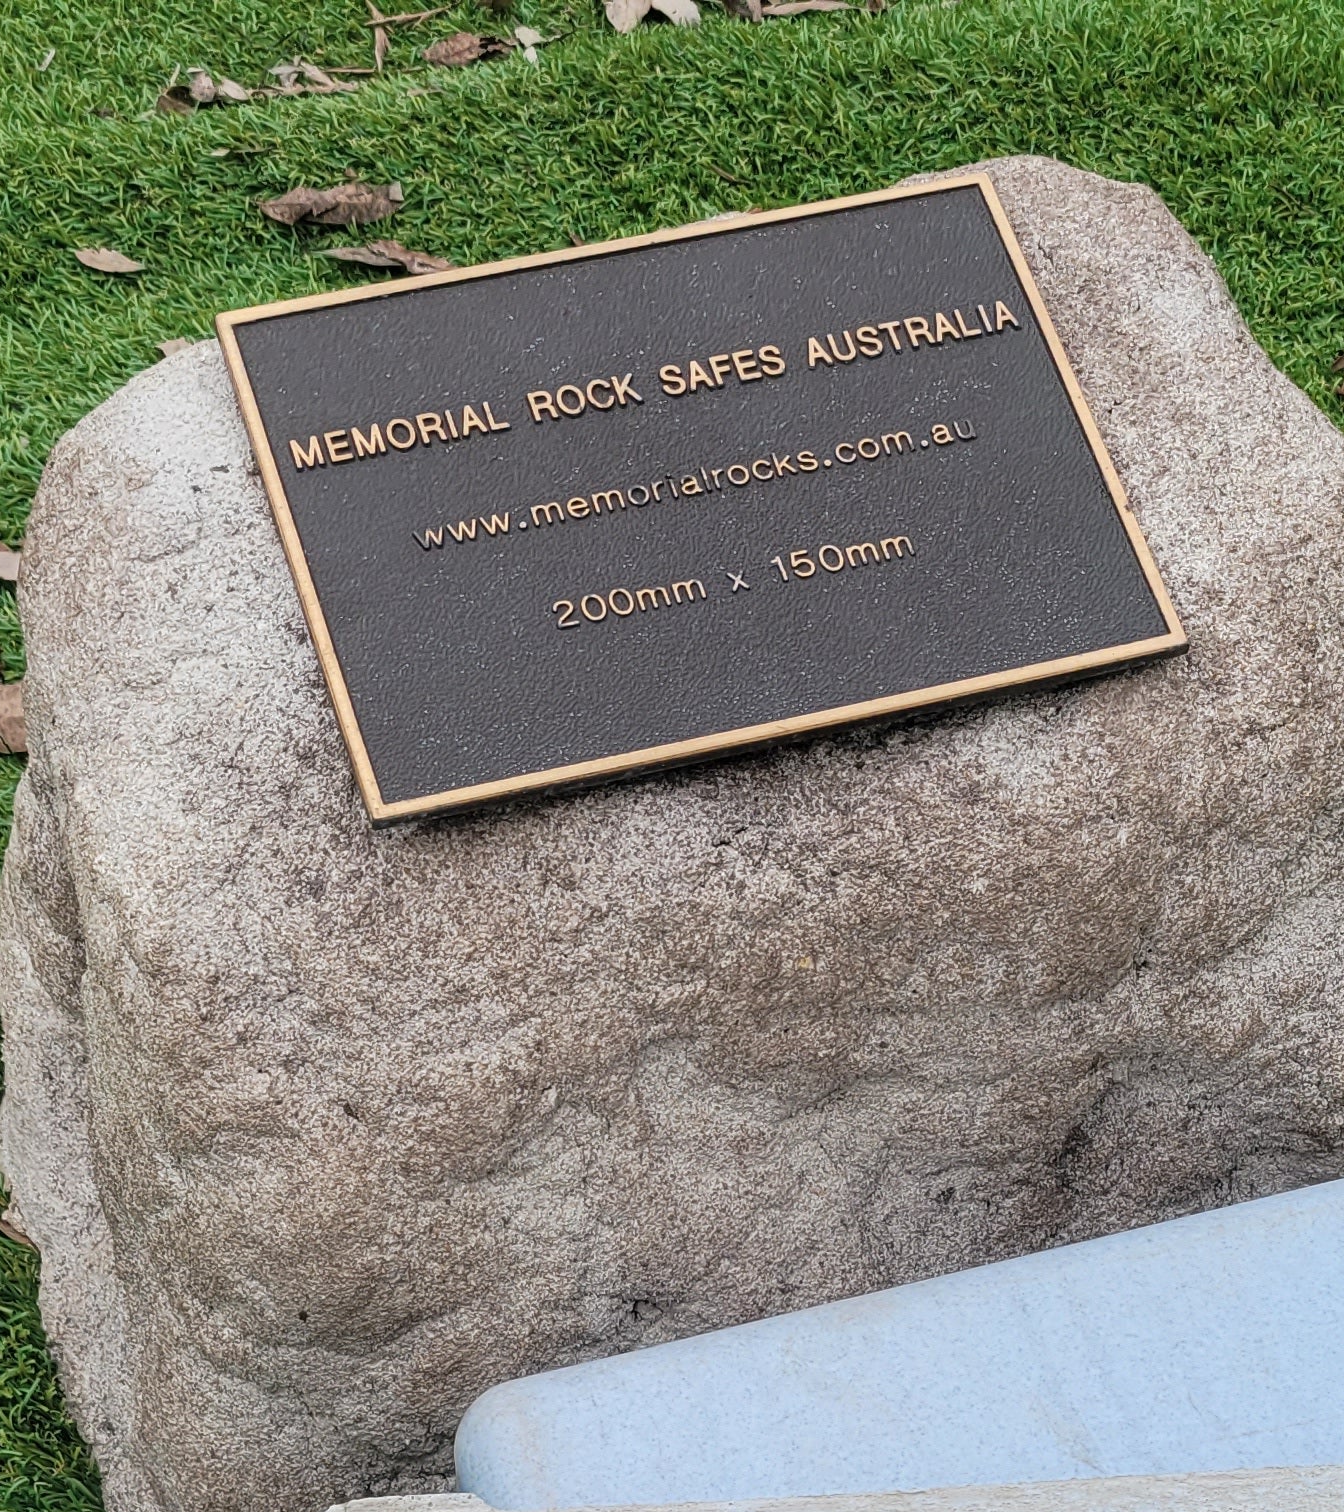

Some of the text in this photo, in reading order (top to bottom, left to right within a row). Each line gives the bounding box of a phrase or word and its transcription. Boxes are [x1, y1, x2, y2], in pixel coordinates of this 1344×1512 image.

[289, 301, 1019, 472] MEMORIAL ROCK SAFES AUSTRALIA
[414, 423, 977, 550] www.memorialrocks.com.au
[552, 530, 916, 629] 200mm x 150mm
